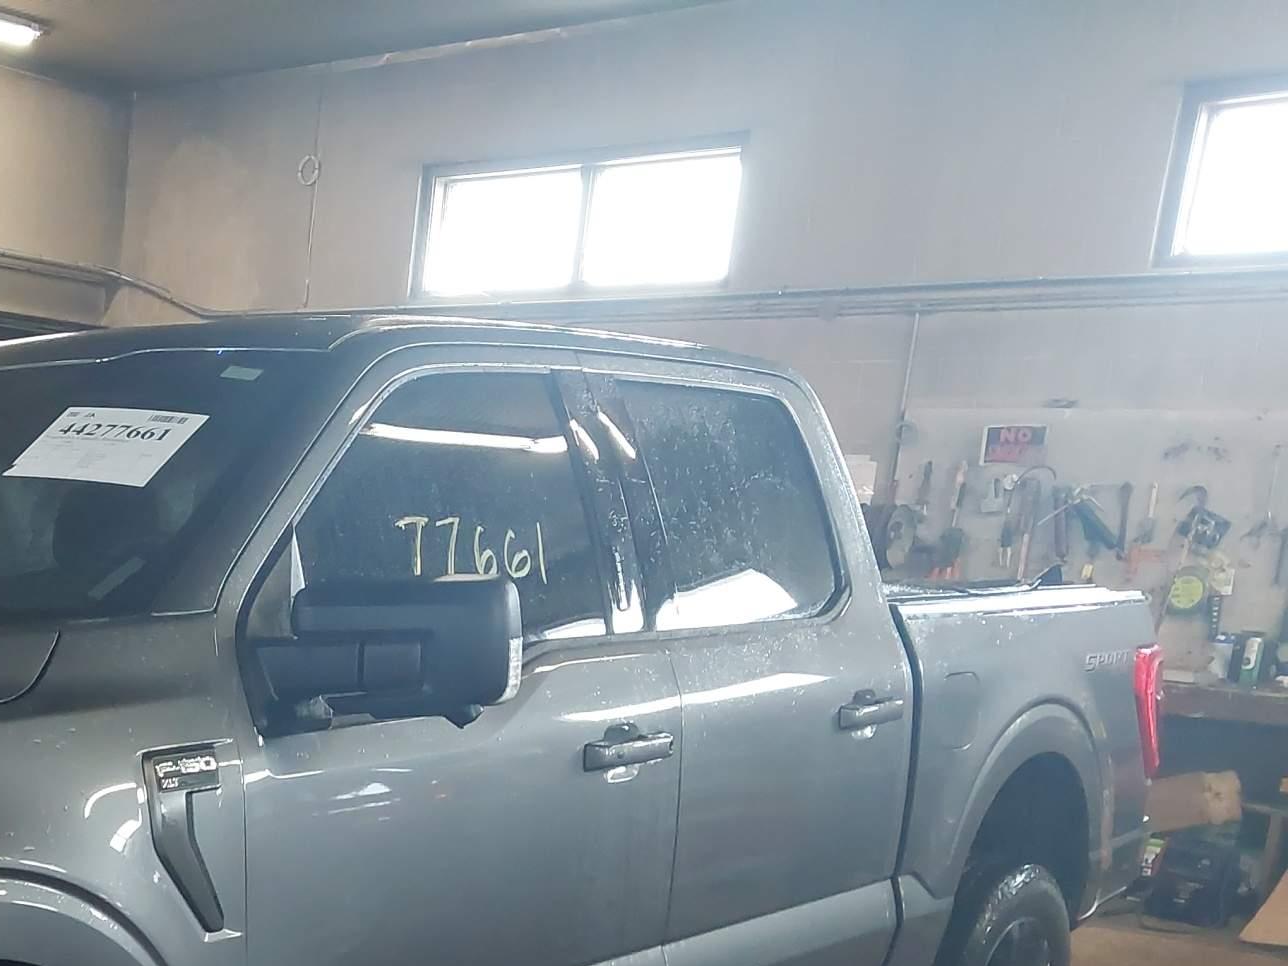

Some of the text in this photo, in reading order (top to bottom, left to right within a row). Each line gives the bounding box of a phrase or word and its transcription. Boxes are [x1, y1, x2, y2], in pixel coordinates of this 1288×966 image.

[58, 422, 173, 442] 44277661
[1000, 429, 1032, 443] NO
[394, 515, 548, 585] 77661
[155, 755, 218, 778] F-150
